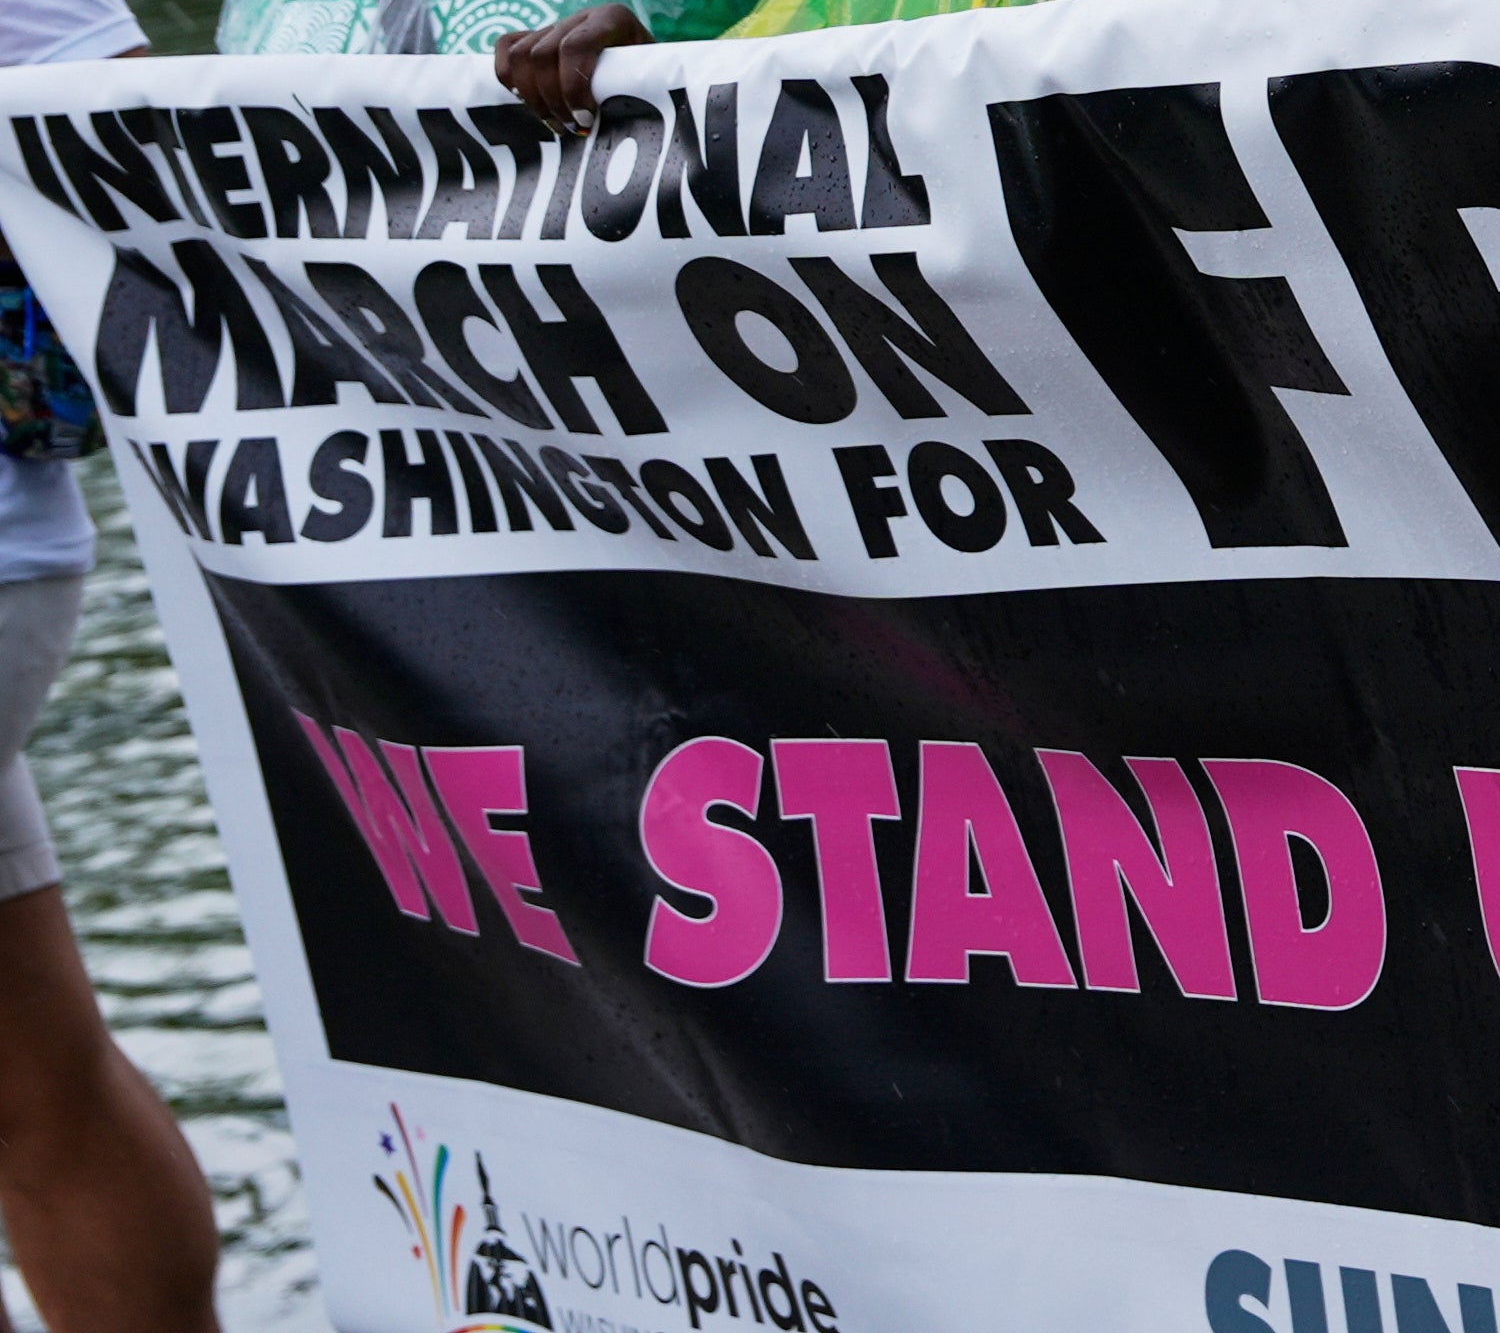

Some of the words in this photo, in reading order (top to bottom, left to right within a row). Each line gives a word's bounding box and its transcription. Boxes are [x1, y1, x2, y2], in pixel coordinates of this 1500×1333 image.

[8, 73, 932, 244] INTERNATIONAL
[93, 238, 669, 436] MARCH
[674, 250, 1033, 425] ON
[124, 425, 819, 562] WASHINGTON
[832, 437, 1108, 560] FOR
[294, 707, 582, 968] WE
[638, 735, 1389, 1013] STAND
[520, 1212, 841, 1333] worldpride
